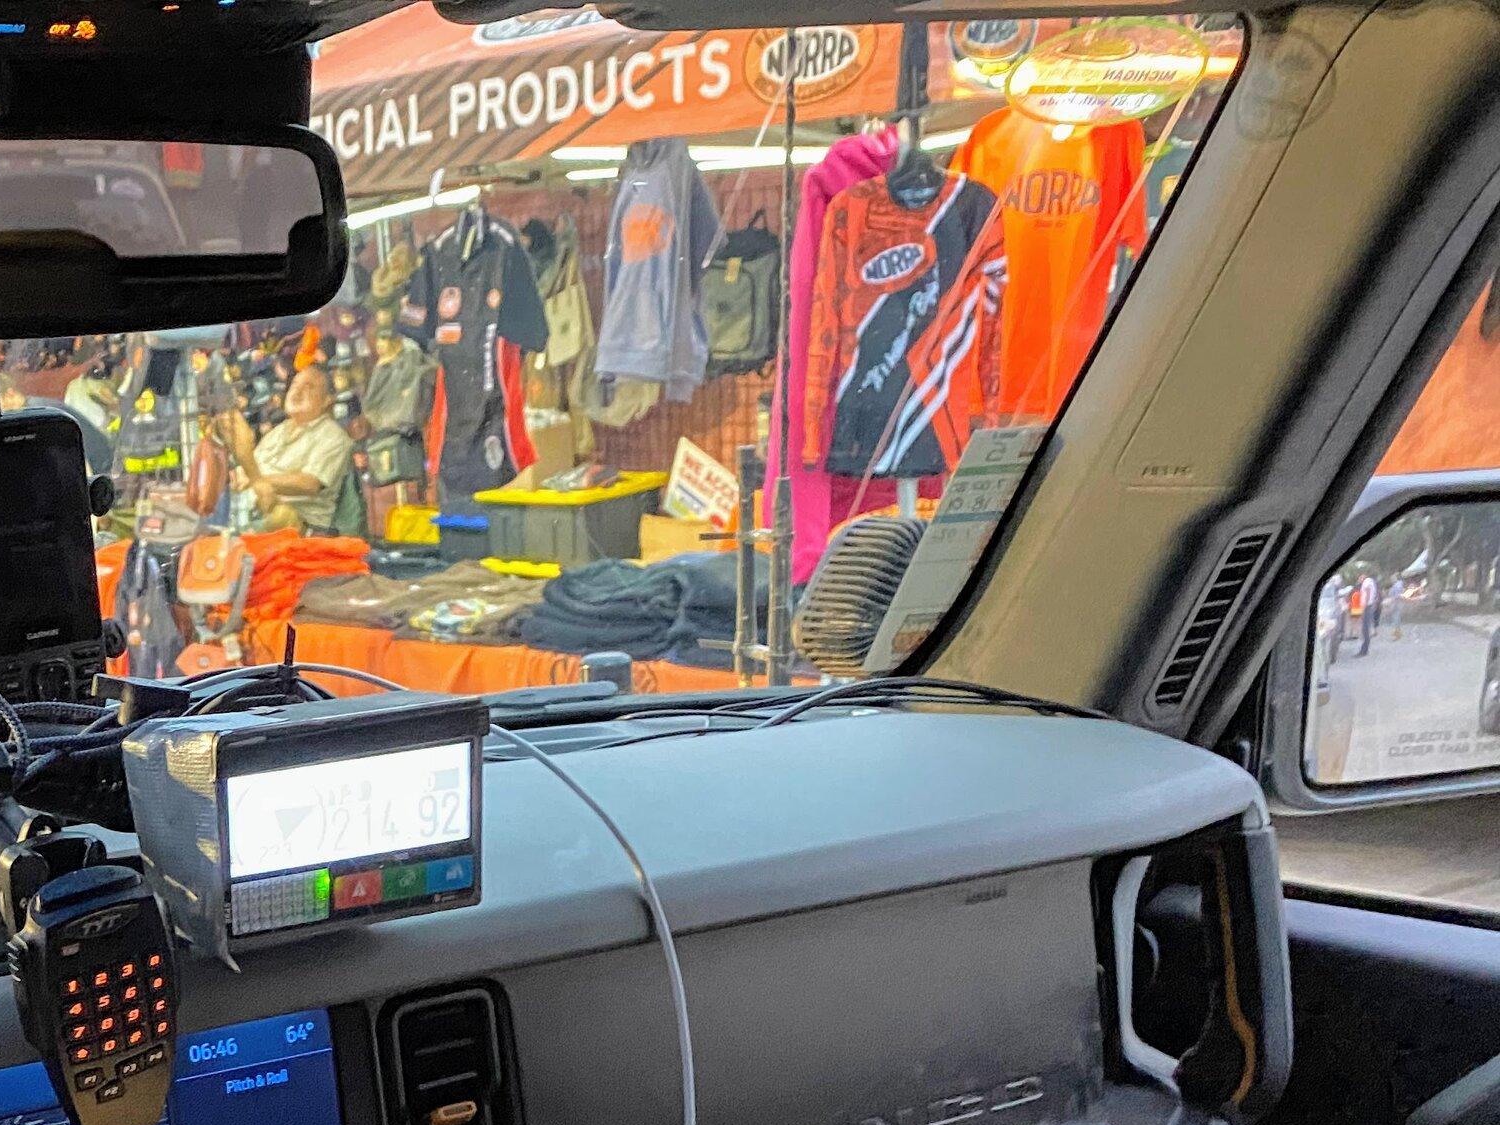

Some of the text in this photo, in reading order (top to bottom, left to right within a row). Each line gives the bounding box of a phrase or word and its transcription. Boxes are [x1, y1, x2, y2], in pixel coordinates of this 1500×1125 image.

[50, 24, 71, 34] OFF
[448, 37, 731, 138] PRODUCTS
[67, 980, 79, 993] 1
[95, 972, 108, 986] 2
[121, 964, 134, 977] 3
[69, 1002, 83, 1016] 4
[99, 995, 110, 1007] 5
[125, 987, 137, 1000] 6
[73, 1026, 86, 1039] 7
[127, 1009, 140, 1022] 9
[189, 1038, 238, 1063] 06:46
[226, 1069, 288, 1094] Pitch & Roll
